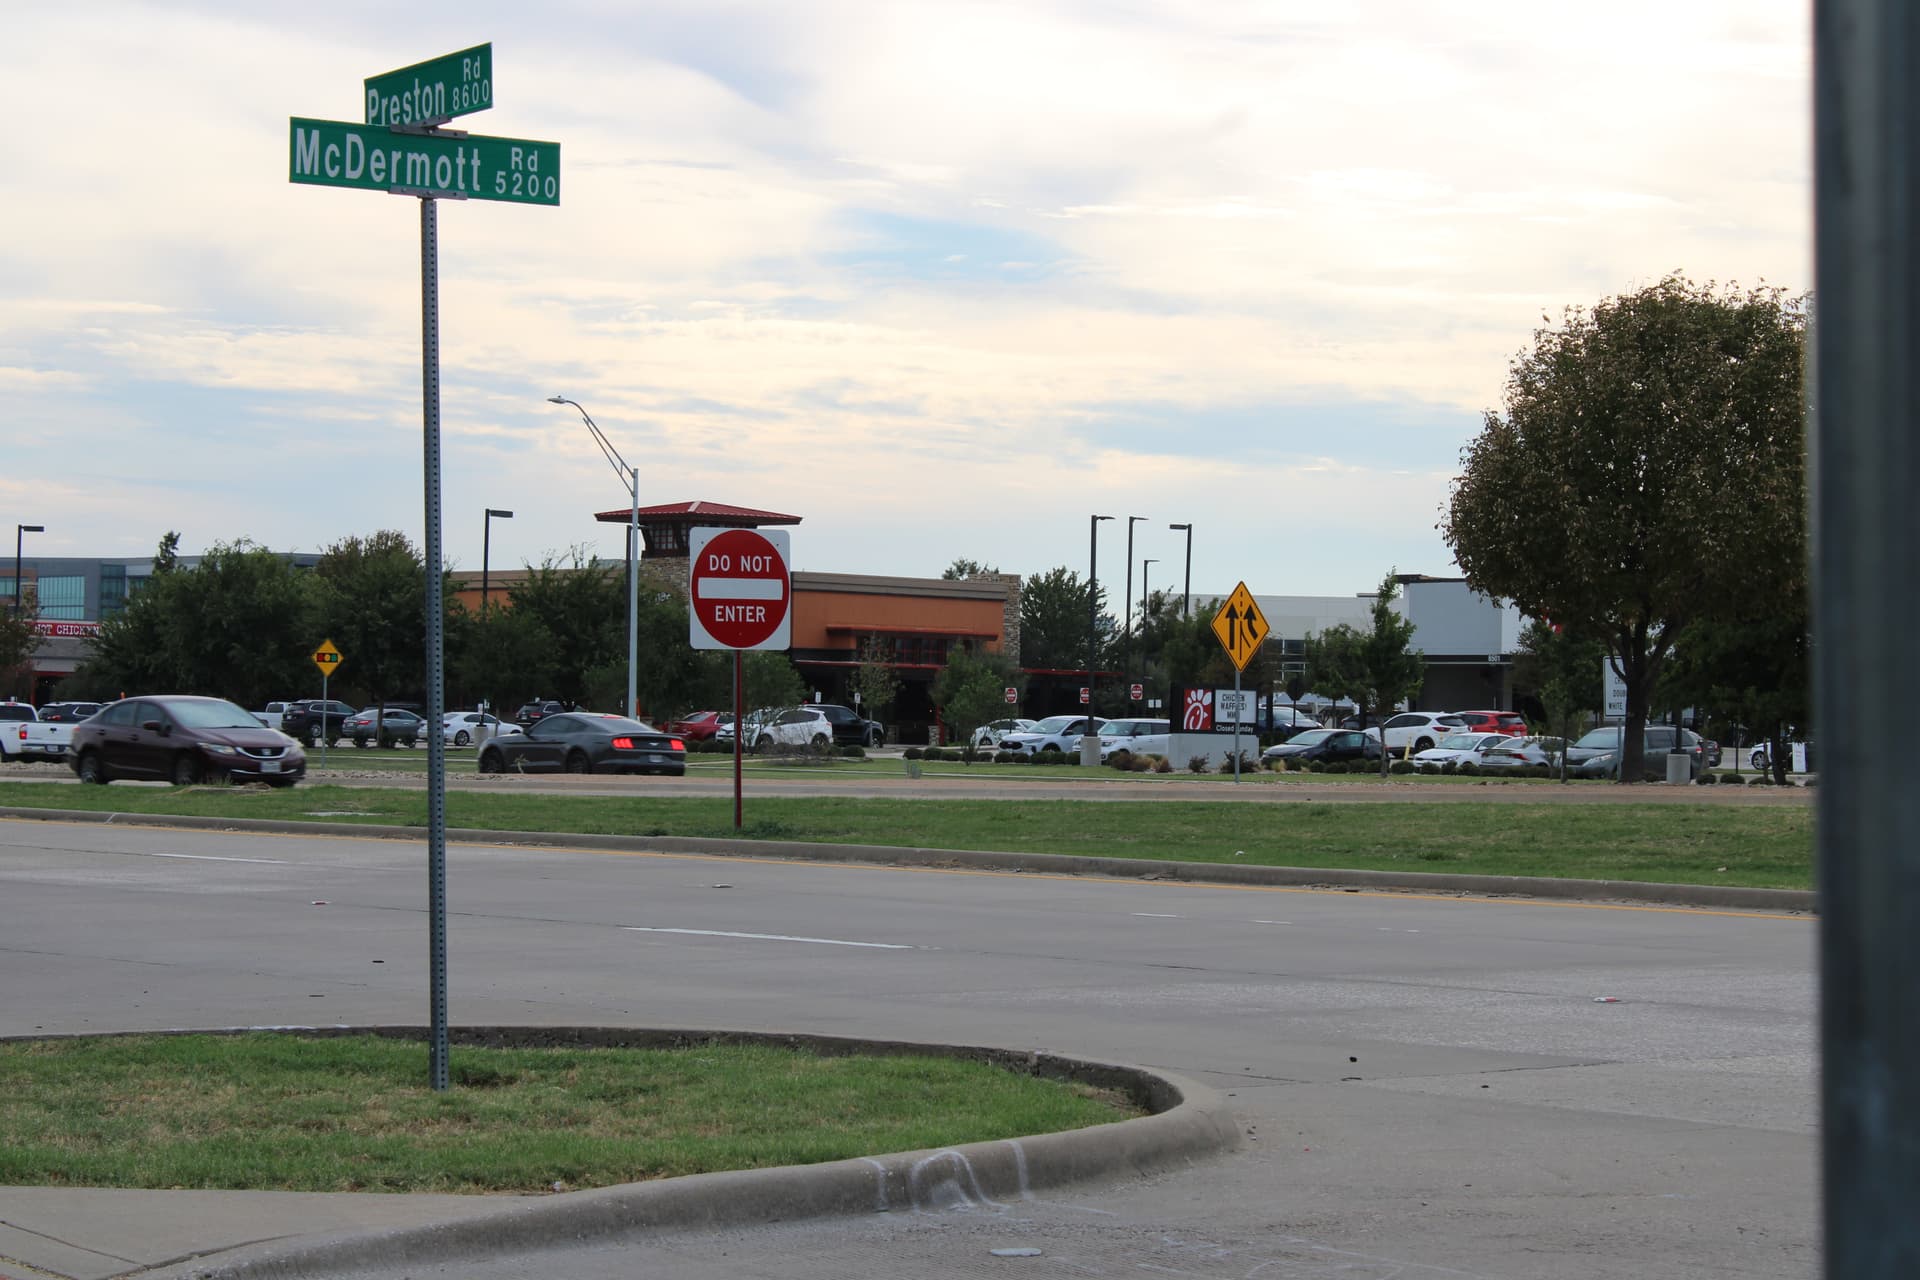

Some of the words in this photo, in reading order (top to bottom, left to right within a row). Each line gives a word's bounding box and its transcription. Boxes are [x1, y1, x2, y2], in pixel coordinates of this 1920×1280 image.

[367, 78, 445, 125] Preston
[463, 55, 481, 82] Rd
[452, 79, 490, 111] 8600
[295, 127, 481, 192] McDermott
[511, 147, 539, 172] Rd
[495, 170, 556, 199] 5200
[709, 554, 731, 572] DO
[741, 555, 772, 573] NOT
[715, 605, 766, 623] ENTER
[1220, 702, 1248, 711] WAFFES!
[1222, 694, 1245, 702] CHICEN
[1215, 724, 1235, 732] Closed
[1236, 725, 1254, 734] unday
